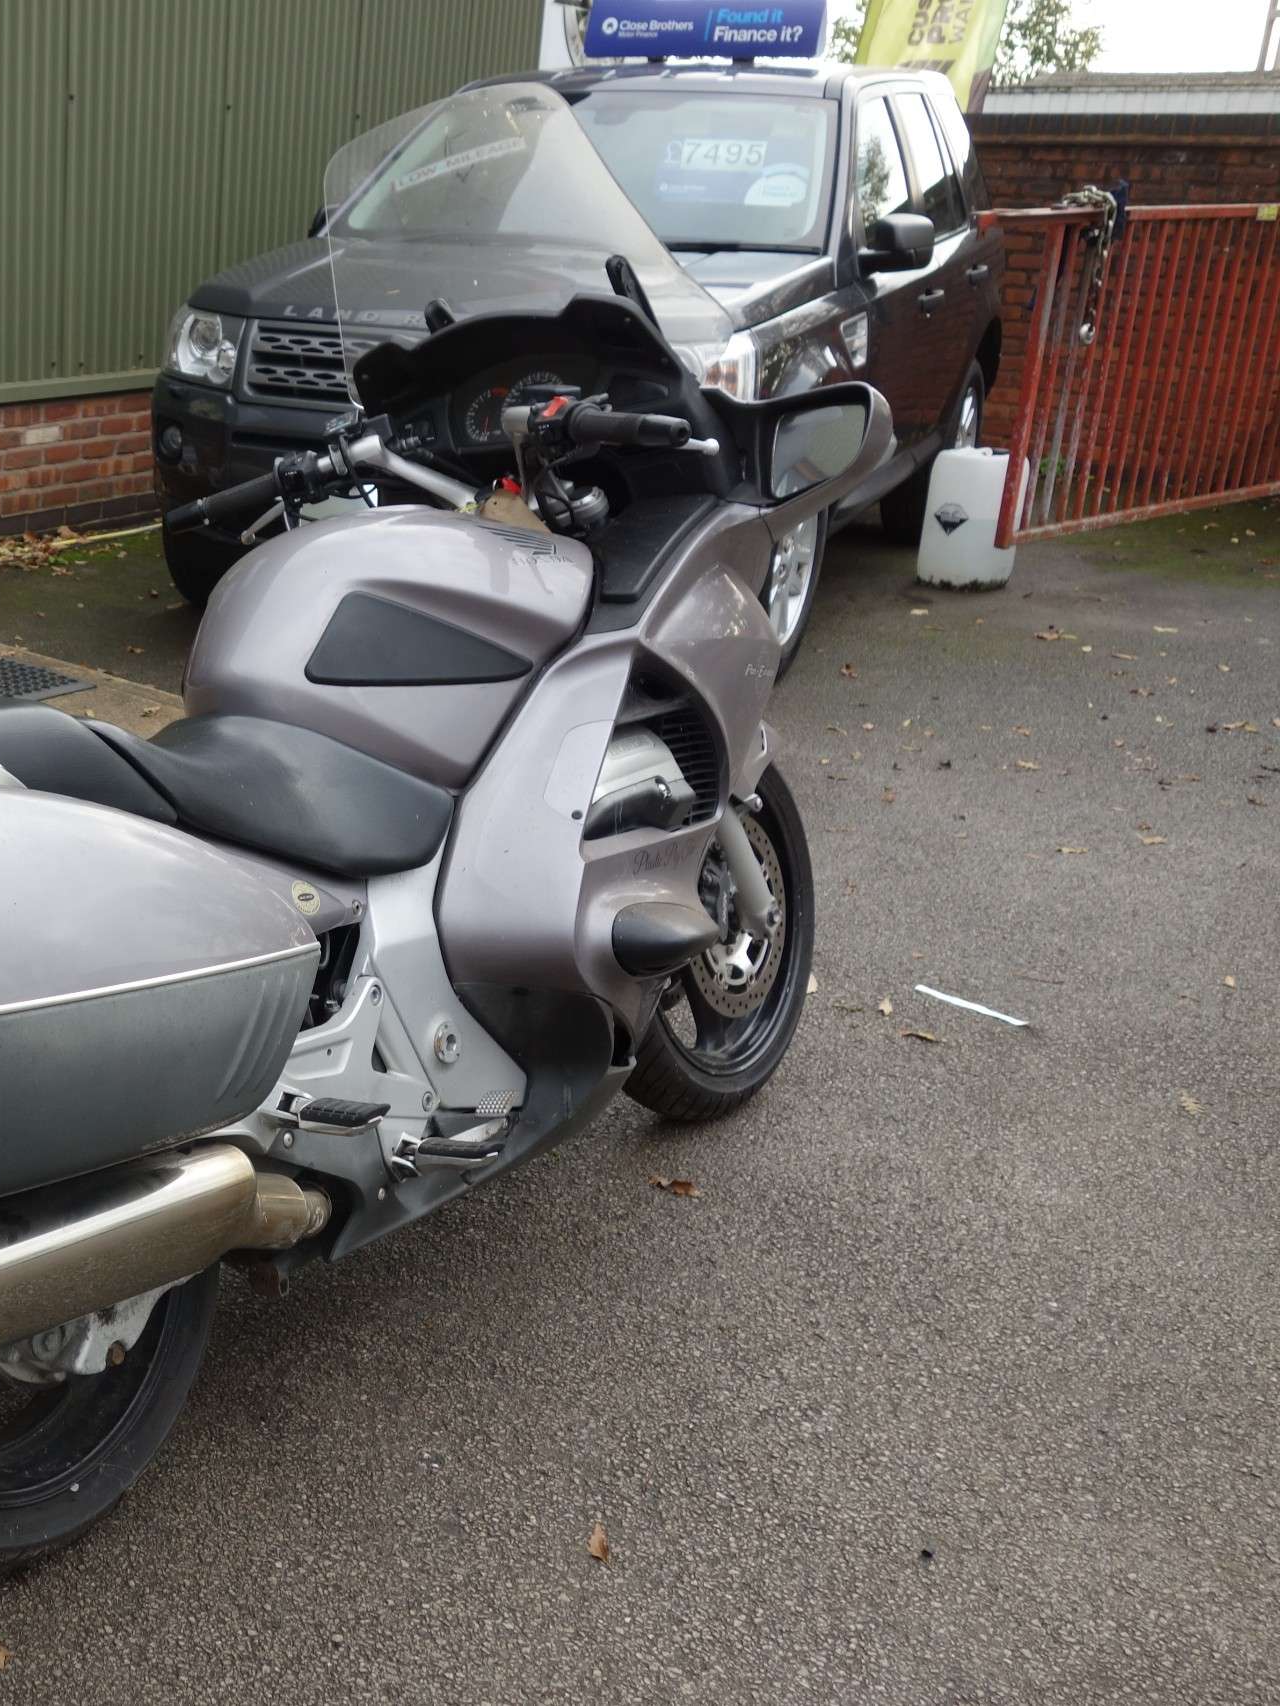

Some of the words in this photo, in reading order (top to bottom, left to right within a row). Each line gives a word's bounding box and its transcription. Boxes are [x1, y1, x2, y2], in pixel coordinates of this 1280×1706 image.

[717, 9, 768, 22] Found
[770, 9, 784, 22] it
[619, 20, 648, 31] Close
[649, 20, 693, 31] Brothers
[713, 26, 777, 42] Finance
[780, 25, 803, 43] it?
[283, 305, 379, 321] LAND
